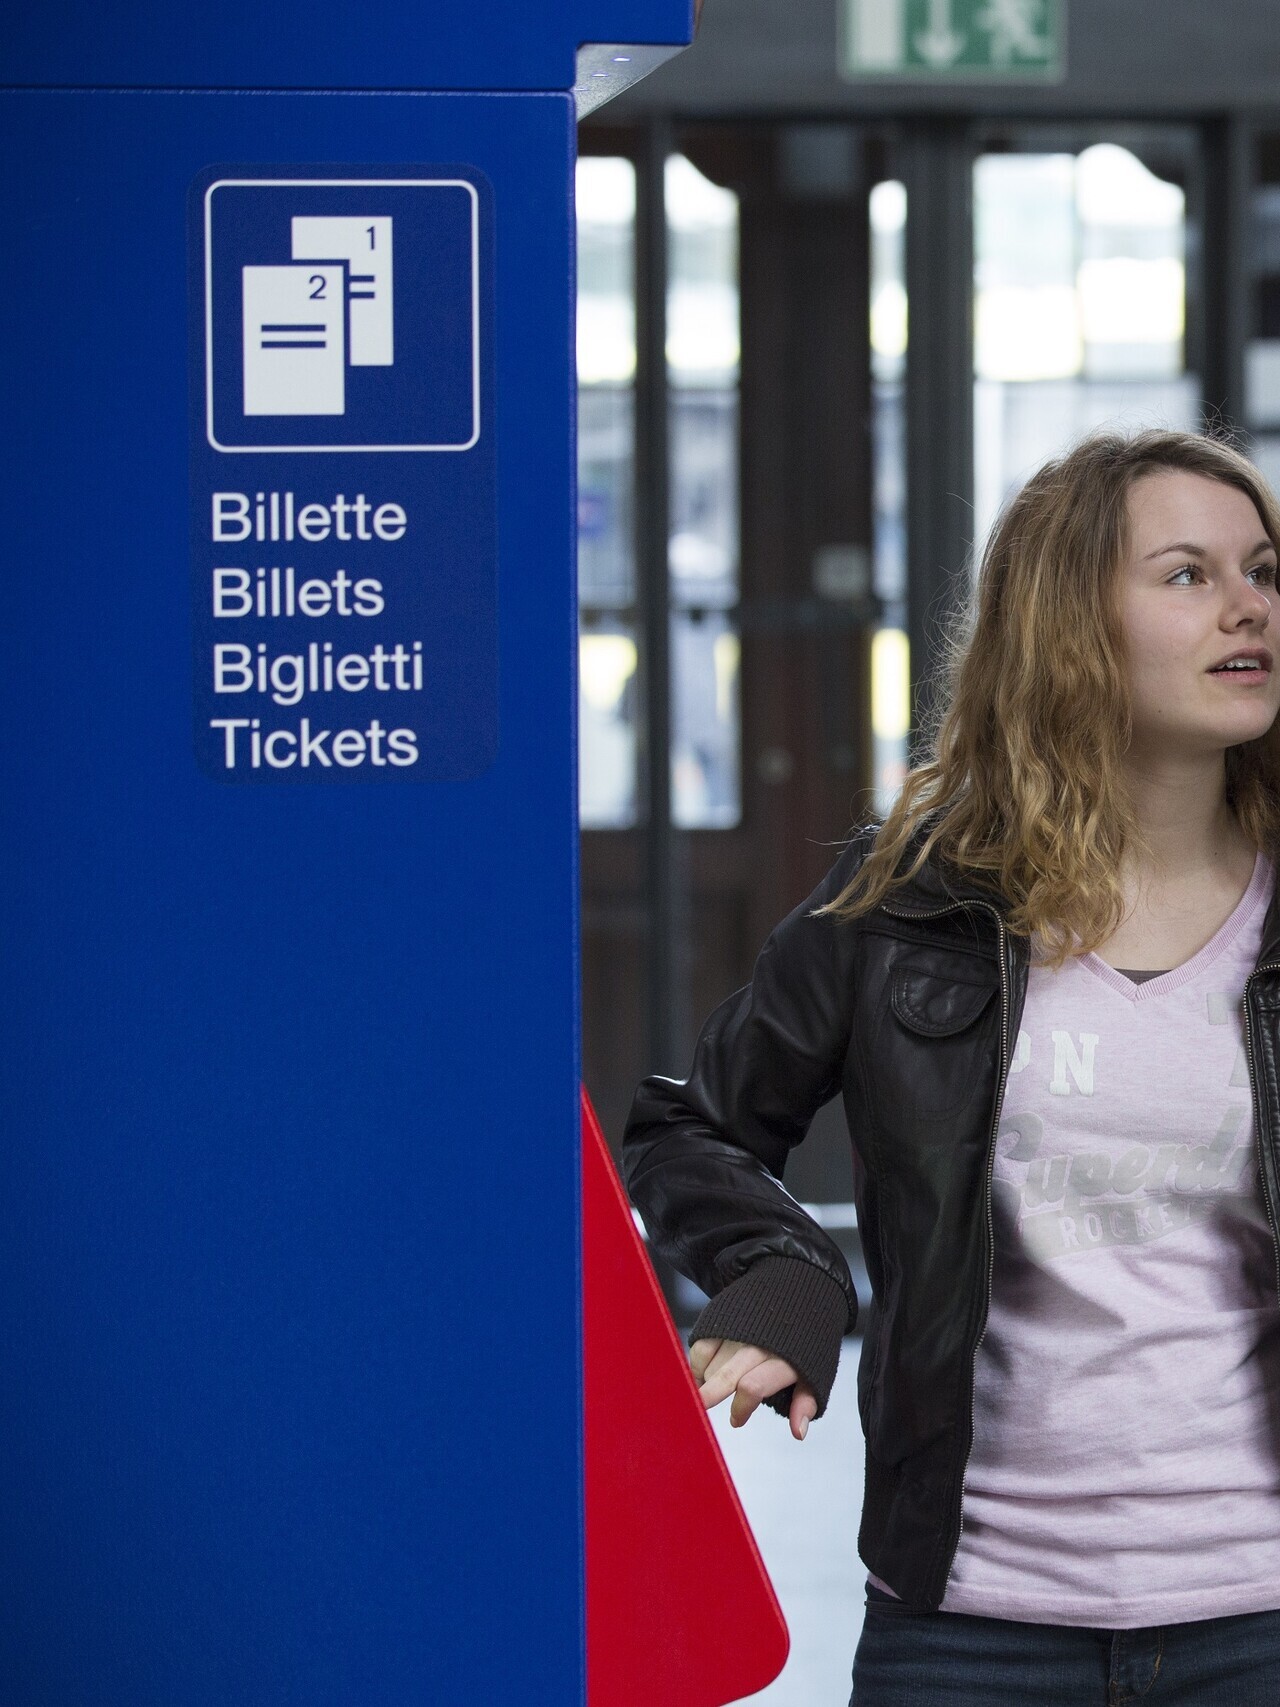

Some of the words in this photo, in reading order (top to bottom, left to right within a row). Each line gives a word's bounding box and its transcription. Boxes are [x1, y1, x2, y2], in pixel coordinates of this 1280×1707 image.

[365, 225, 377, 252] 1
[308, 274, 328, 300] 2
[212, 491, 407, 542] Billette
[212, 567, 385, 618] Billets
[213, 641, 423, 706] Biglietti
[210, 718, 419, 769] Tickets
